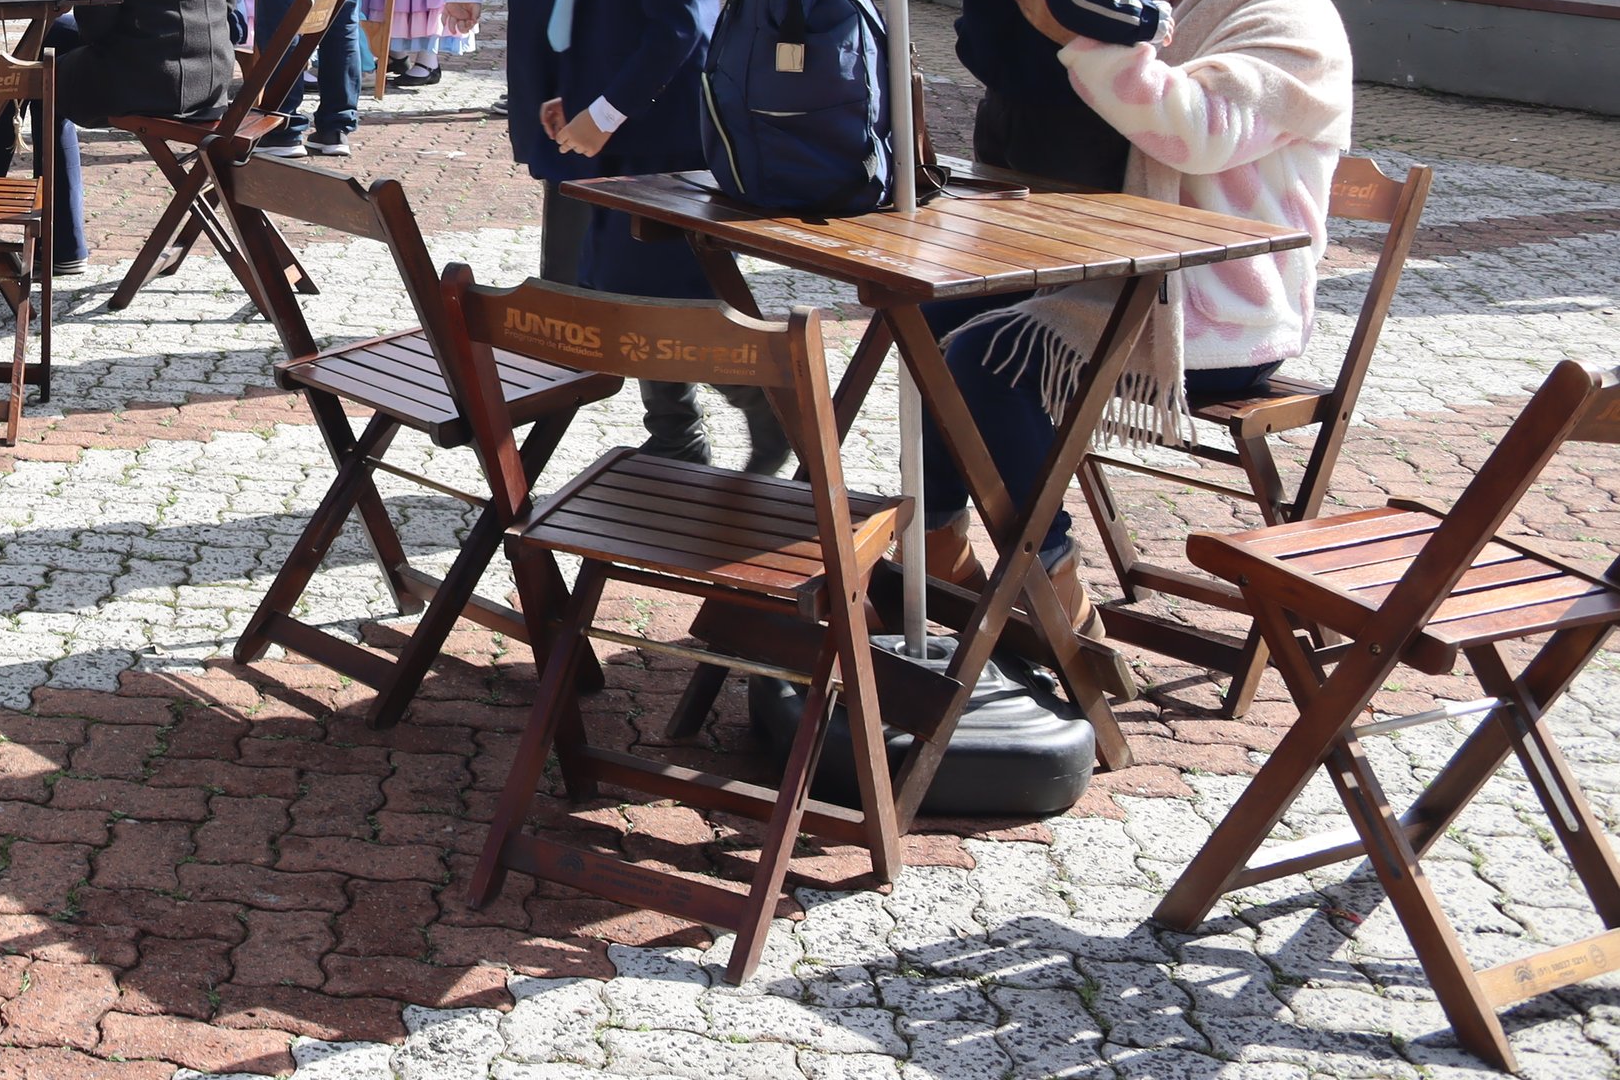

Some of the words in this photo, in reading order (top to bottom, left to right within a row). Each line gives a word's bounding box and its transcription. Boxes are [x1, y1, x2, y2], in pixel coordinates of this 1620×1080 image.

[503, 307, 602, 350] JUNTOS
[504, 328, 545, 345] Programa
[546, 338, 558, 349] de
[558, 342, 604, 359] Fidelidade
[656, 339, 758, 365] Sicredi
[713, 365, 757, 376] Pioneira
